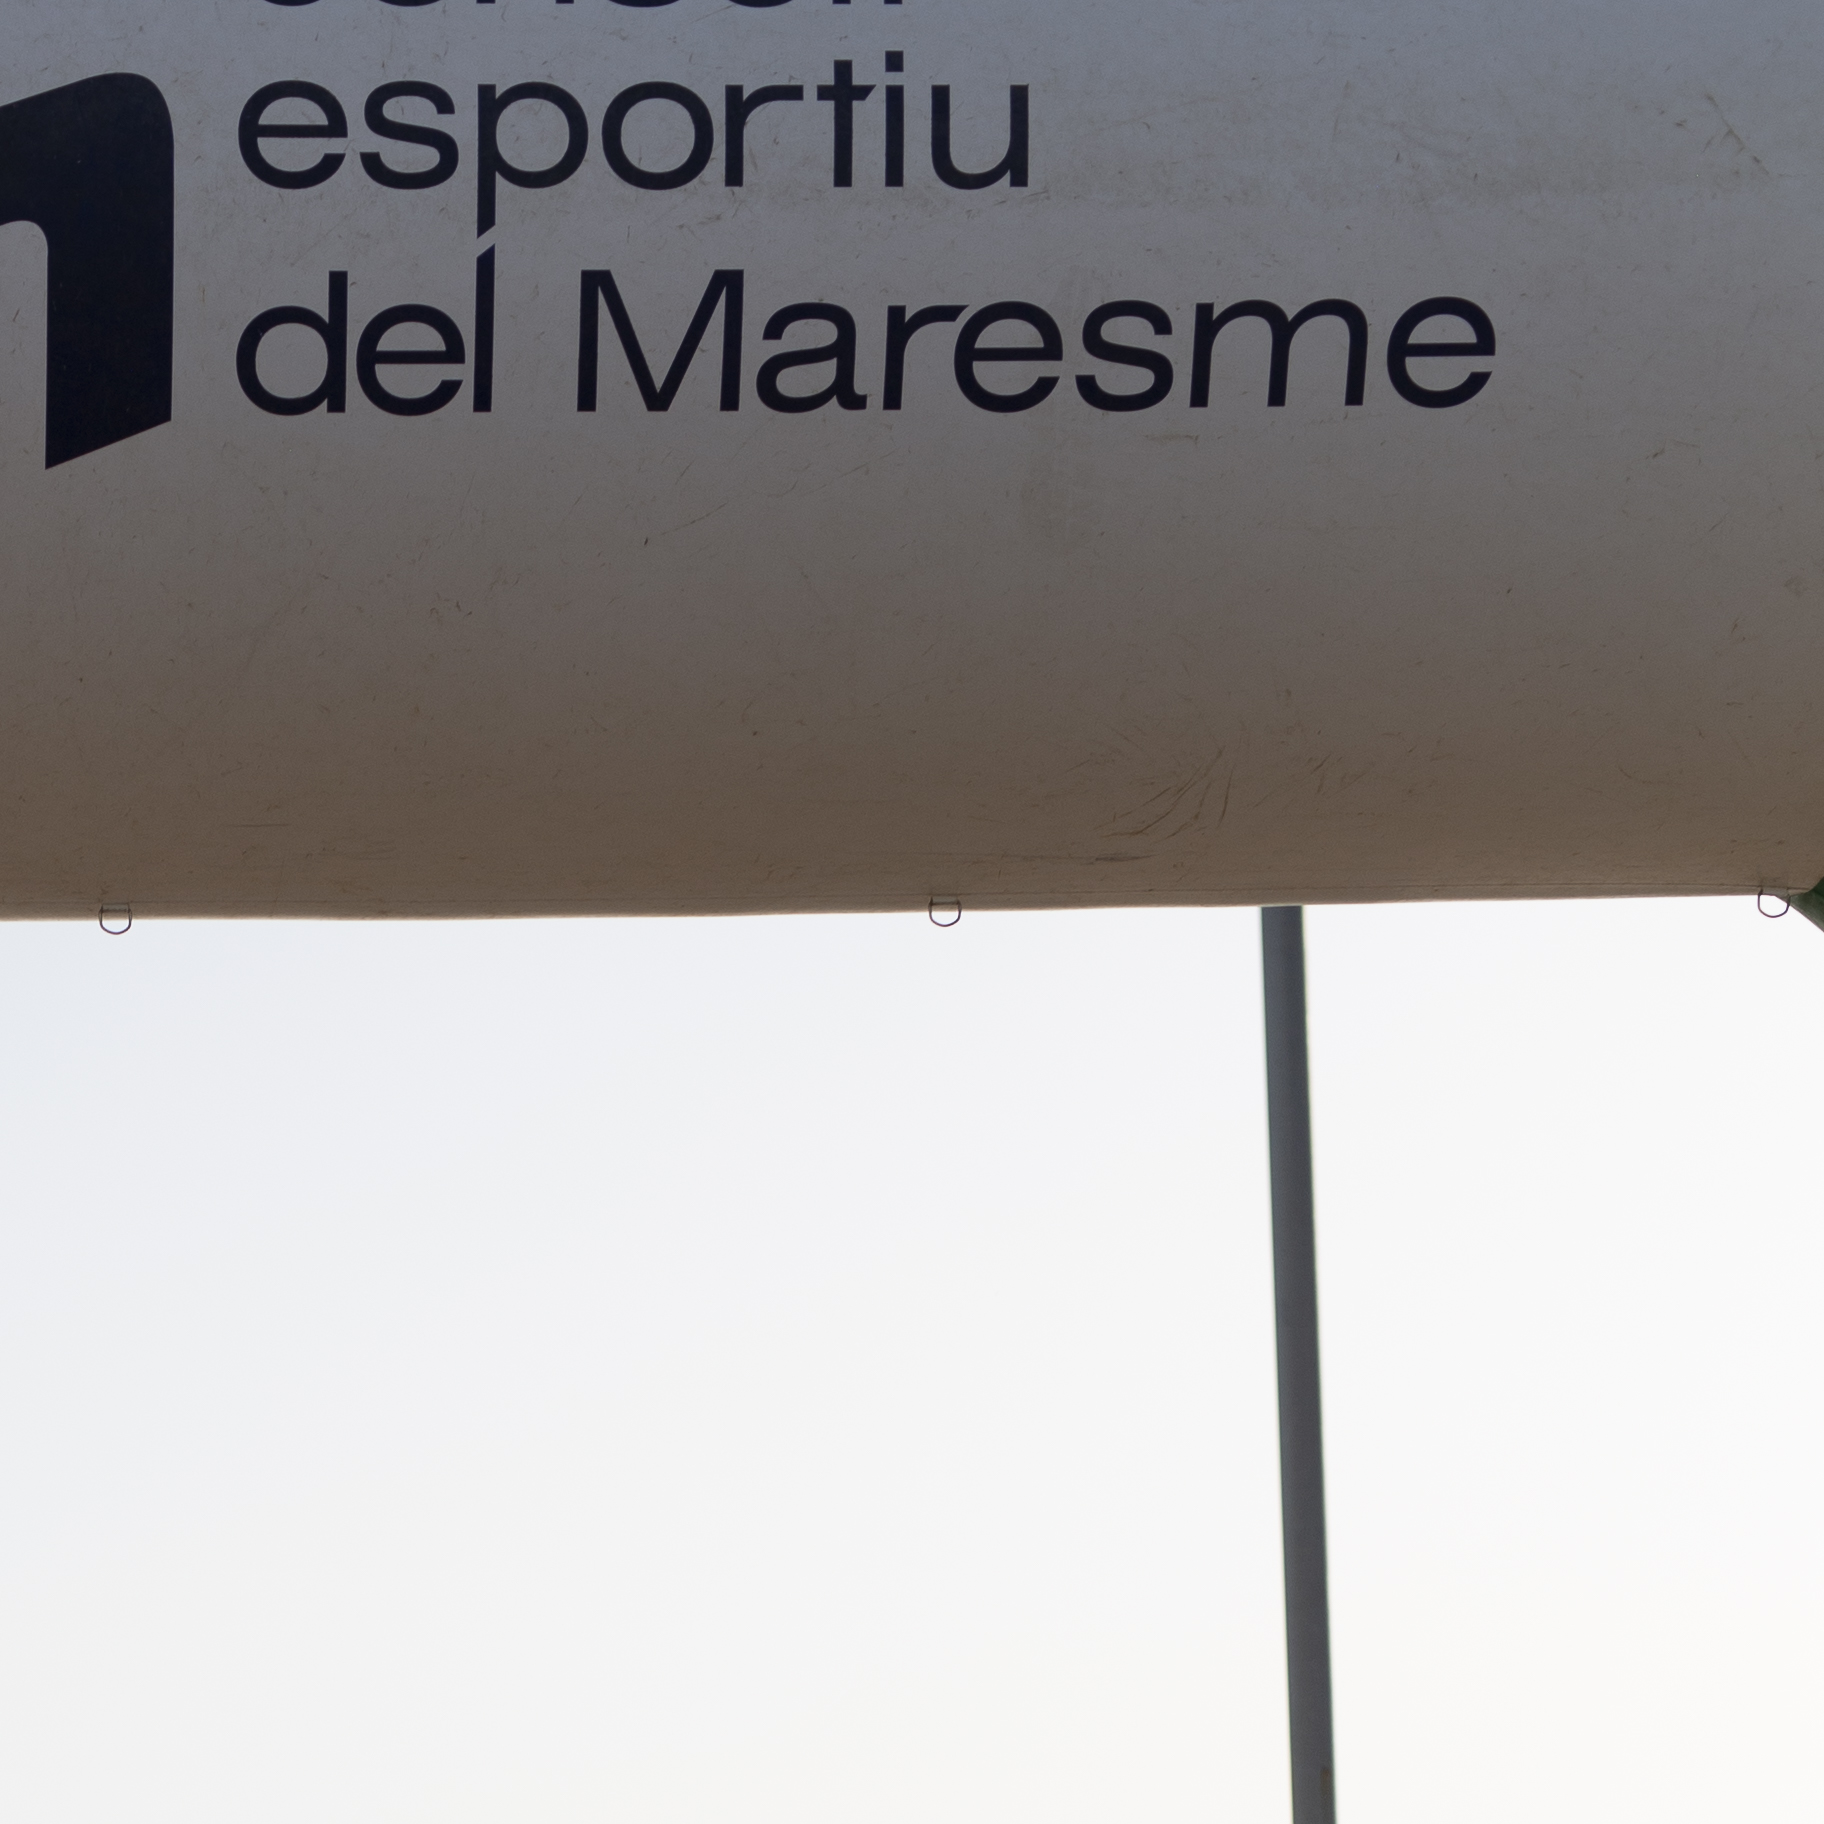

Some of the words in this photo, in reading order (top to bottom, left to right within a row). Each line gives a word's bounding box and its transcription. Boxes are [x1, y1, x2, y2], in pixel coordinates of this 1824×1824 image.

[237, 50, 1030, 239] esportiu
[233, 244, 496, 416] del
[576, 268, 1497, 414] Maresme
